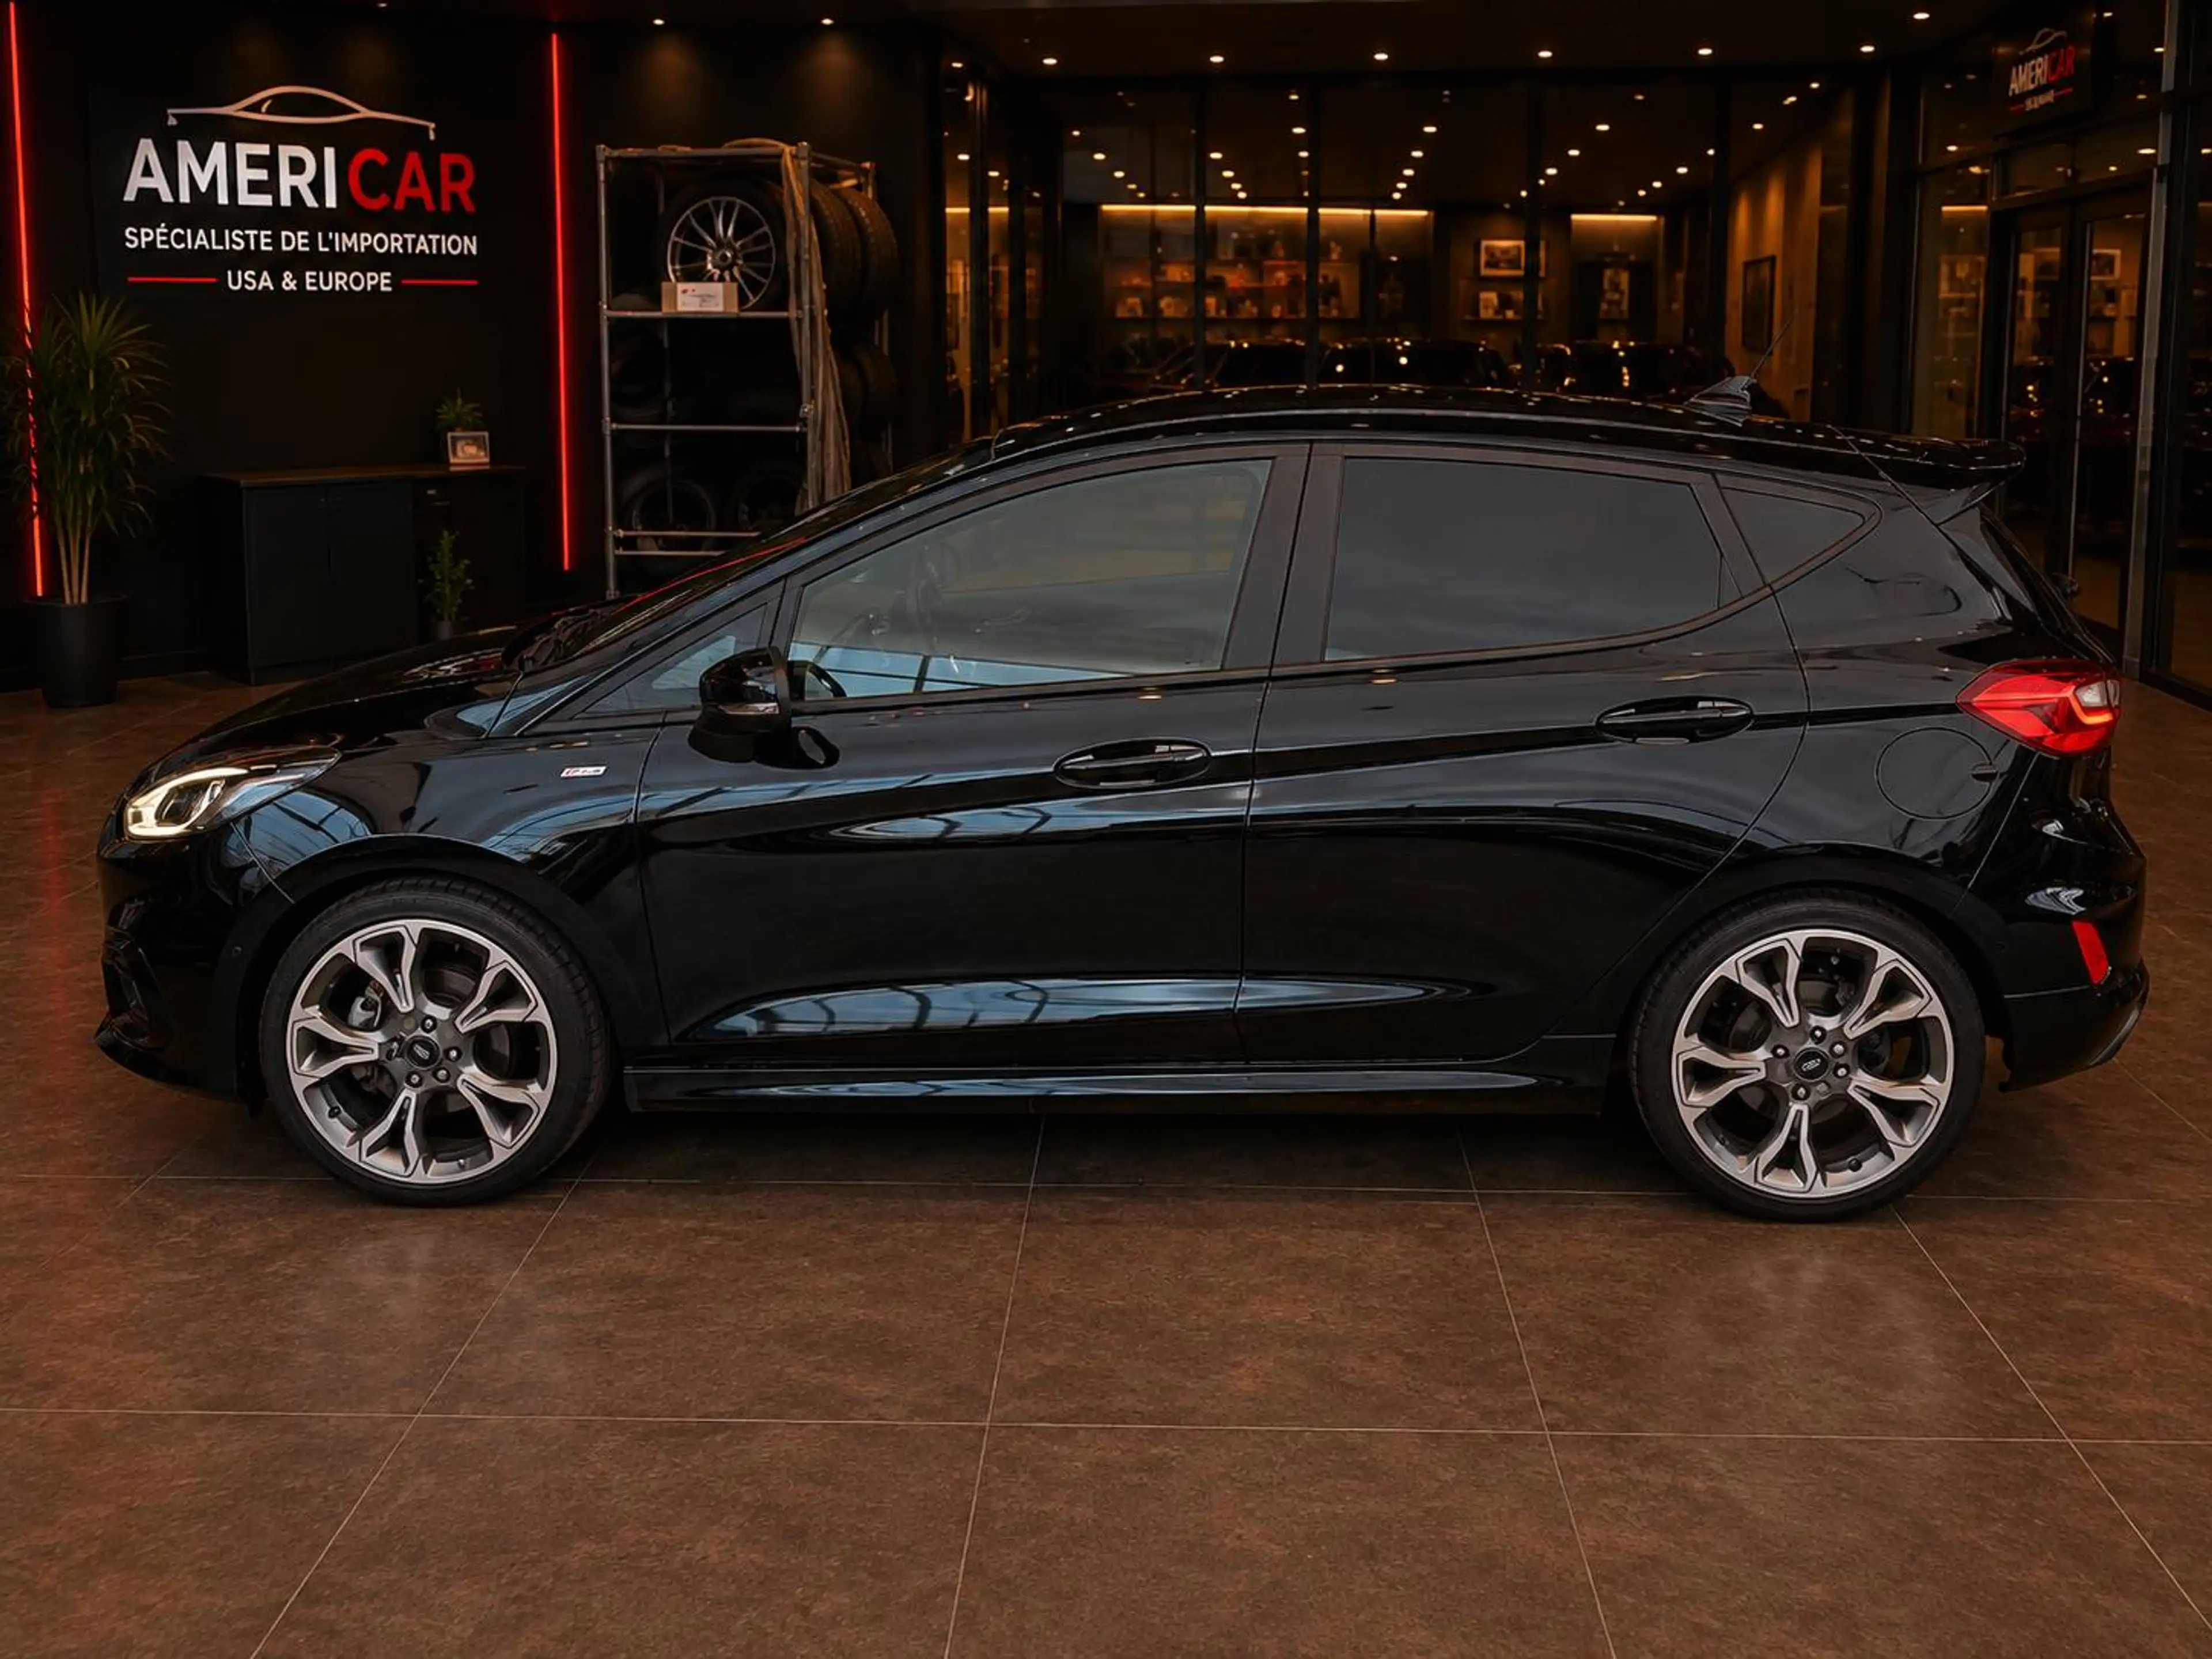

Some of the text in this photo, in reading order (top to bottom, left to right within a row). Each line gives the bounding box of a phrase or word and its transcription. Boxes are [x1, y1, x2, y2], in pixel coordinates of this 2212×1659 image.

[123, 137, 476, 213] AMERICAR
[124, 222, 478, 256] SPÉCIALISTE DE L'IMPORTATION
[226, 269, 393, 291] USA & EUROPE
